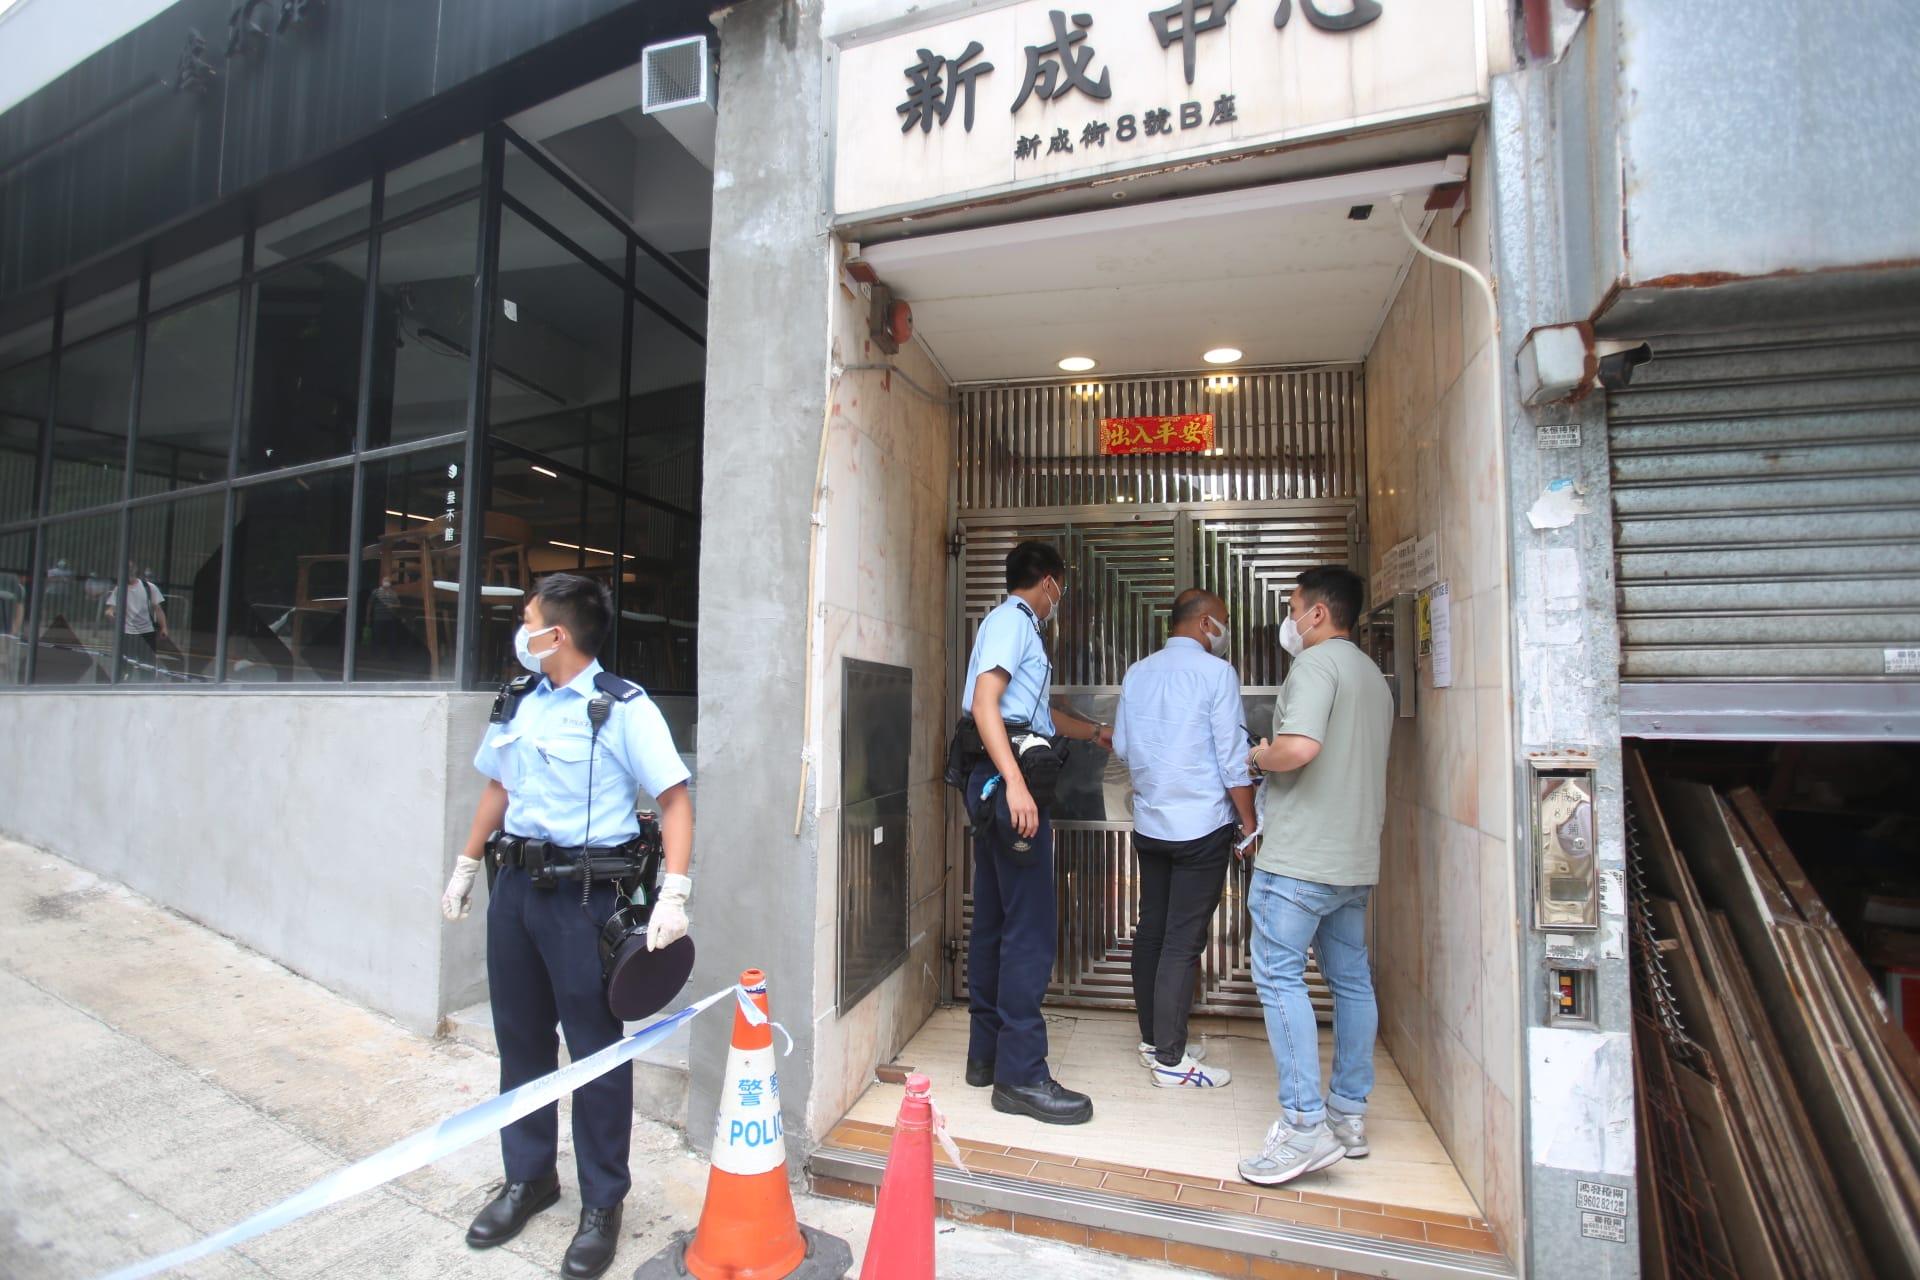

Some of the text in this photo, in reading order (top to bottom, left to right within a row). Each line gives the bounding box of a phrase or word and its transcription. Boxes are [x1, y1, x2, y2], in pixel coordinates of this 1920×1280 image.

[1014, 94, 1238, 160] 新成街8號B座
[1111, 418, 1203, 447] 出入平安
[1583, 1194, 1618, 1212] 96028212
